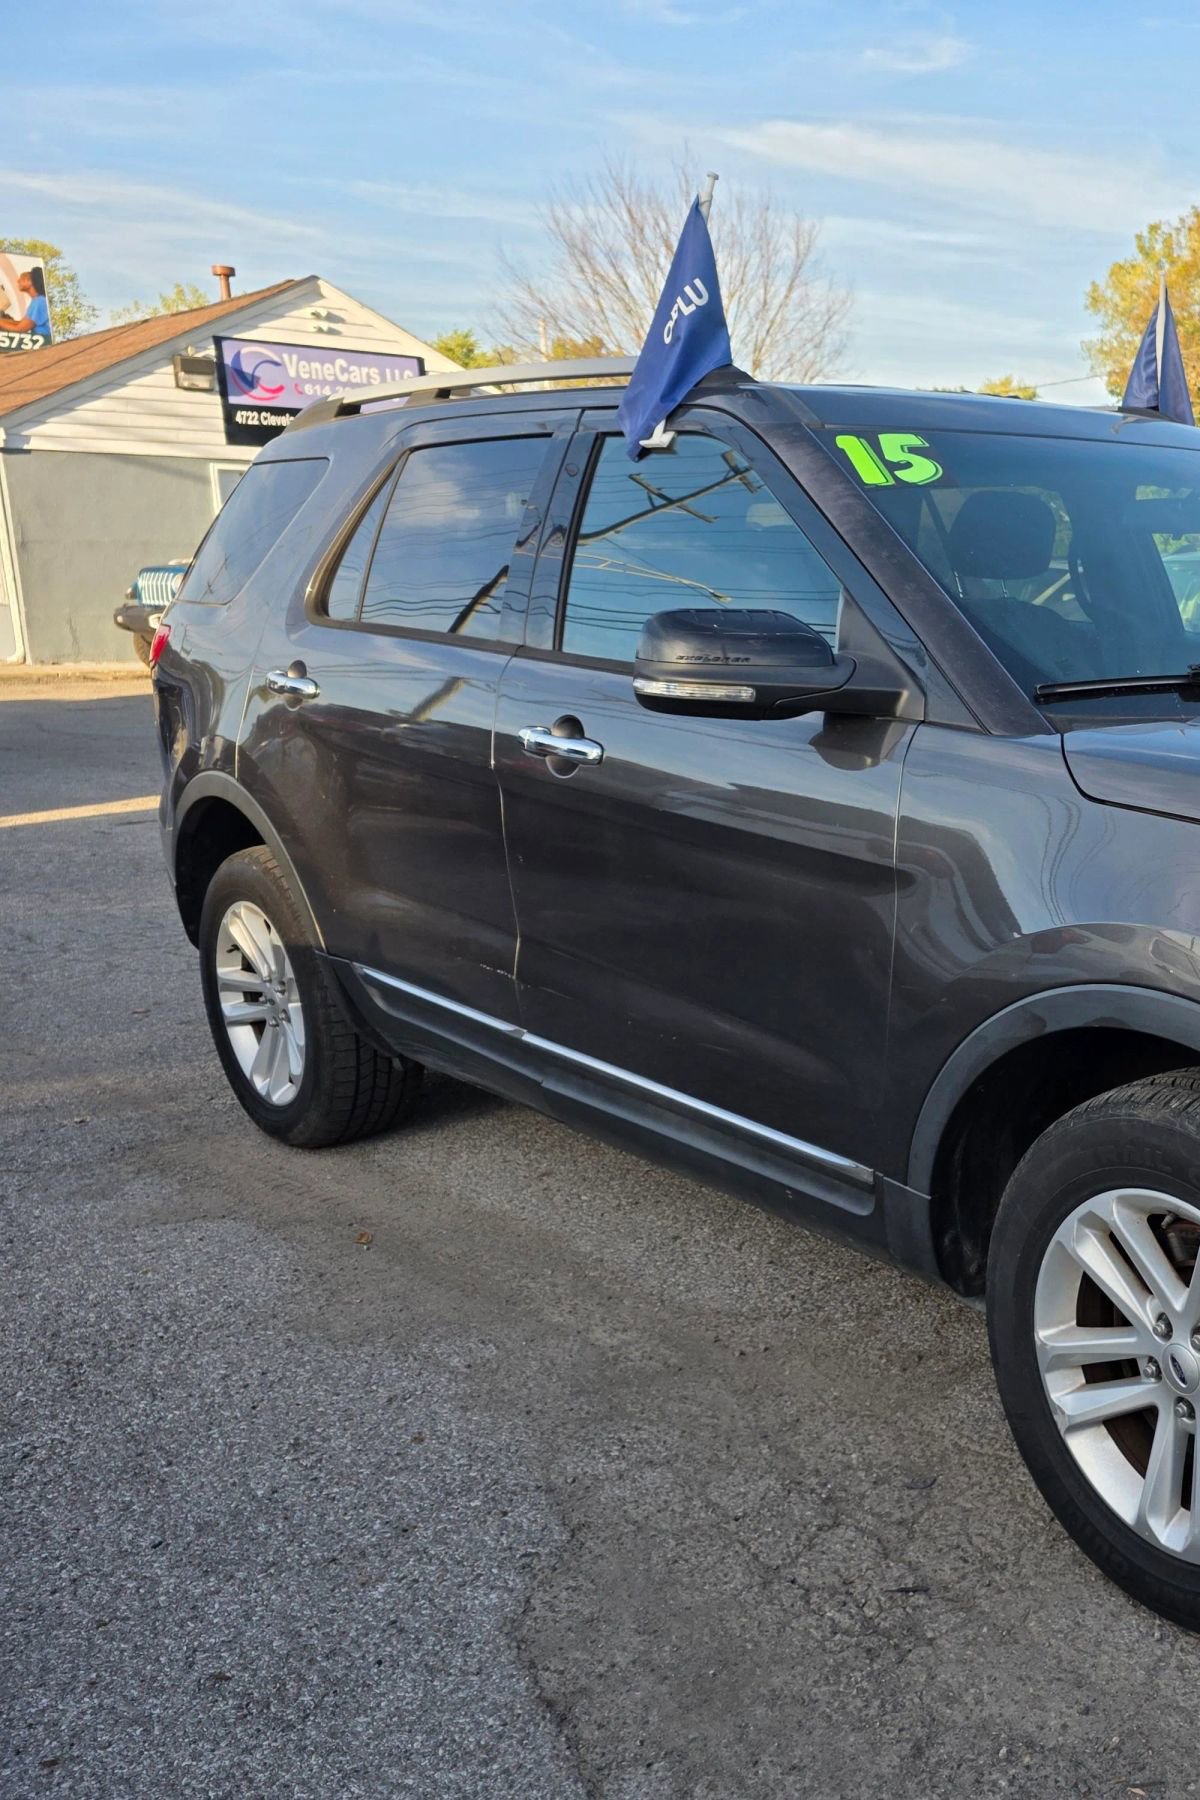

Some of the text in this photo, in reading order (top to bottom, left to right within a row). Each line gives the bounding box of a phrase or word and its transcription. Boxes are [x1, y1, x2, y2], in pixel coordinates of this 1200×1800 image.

[0, 331, 44, 350] 5732
[282, 353, 381, 385] VeneCars
[304, 384, 332, 396] 614
[235, 410, 259, 425] 4722
[835, 433, 943, 486] 15
